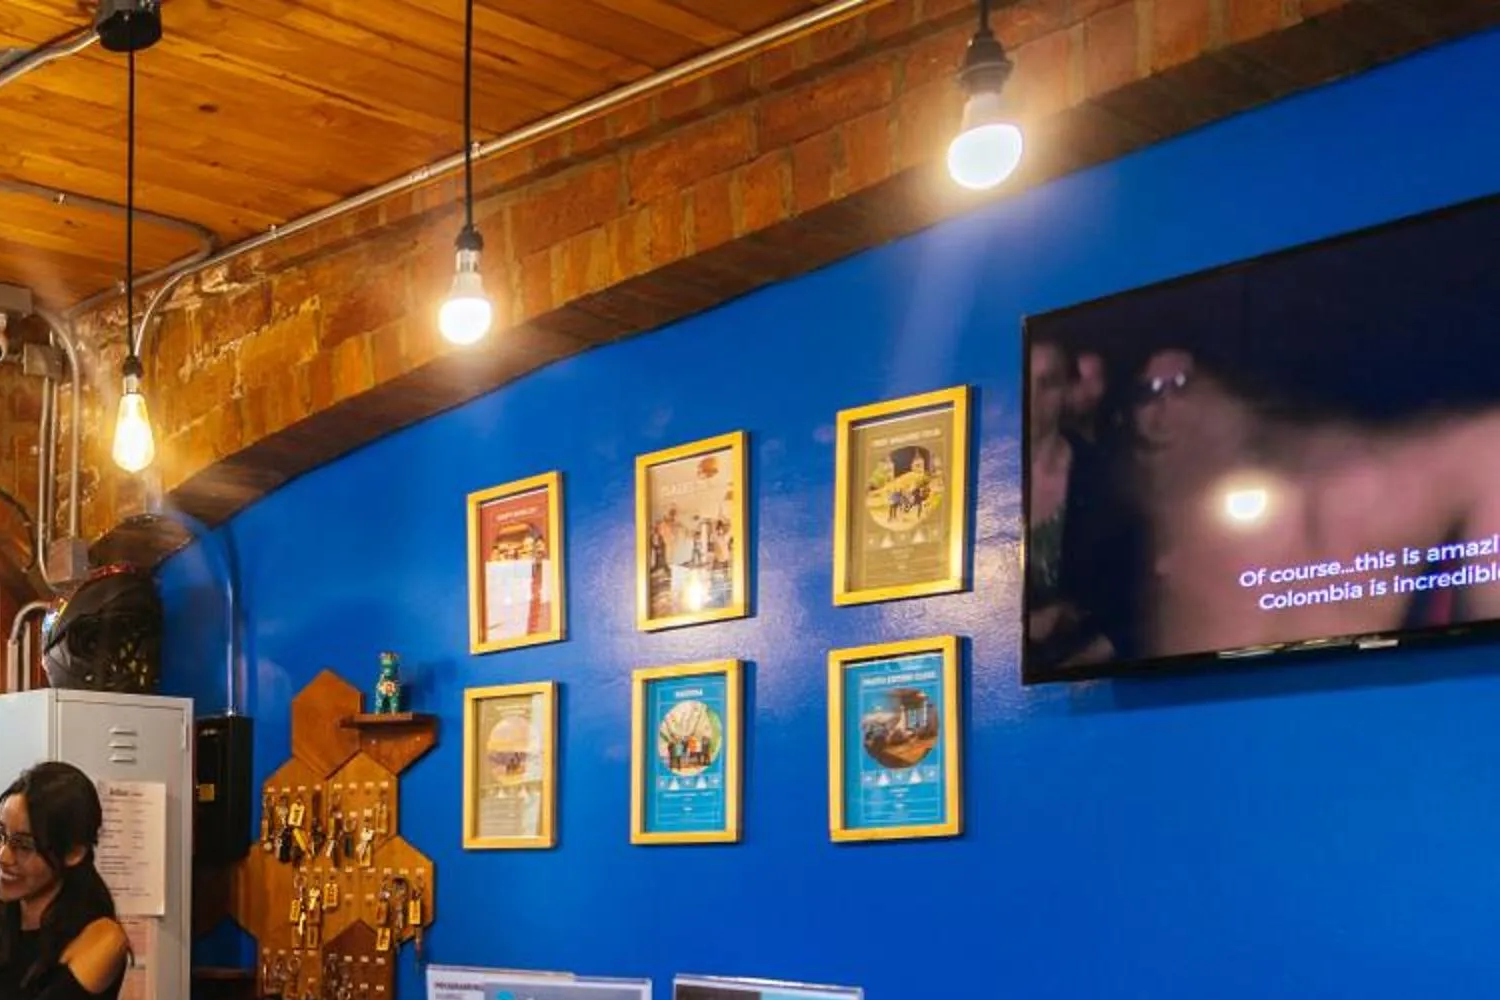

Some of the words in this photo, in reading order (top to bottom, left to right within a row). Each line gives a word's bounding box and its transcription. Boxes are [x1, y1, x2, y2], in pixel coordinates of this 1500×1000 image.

[1239, 569, 1266, 587] Of
[1402, 547, 1421, 566] is
[1259, 582, 1363, 610] Colombia
[1369, 578, 1388, 597] is
[1393, 563, 1500, 593] incredibl
